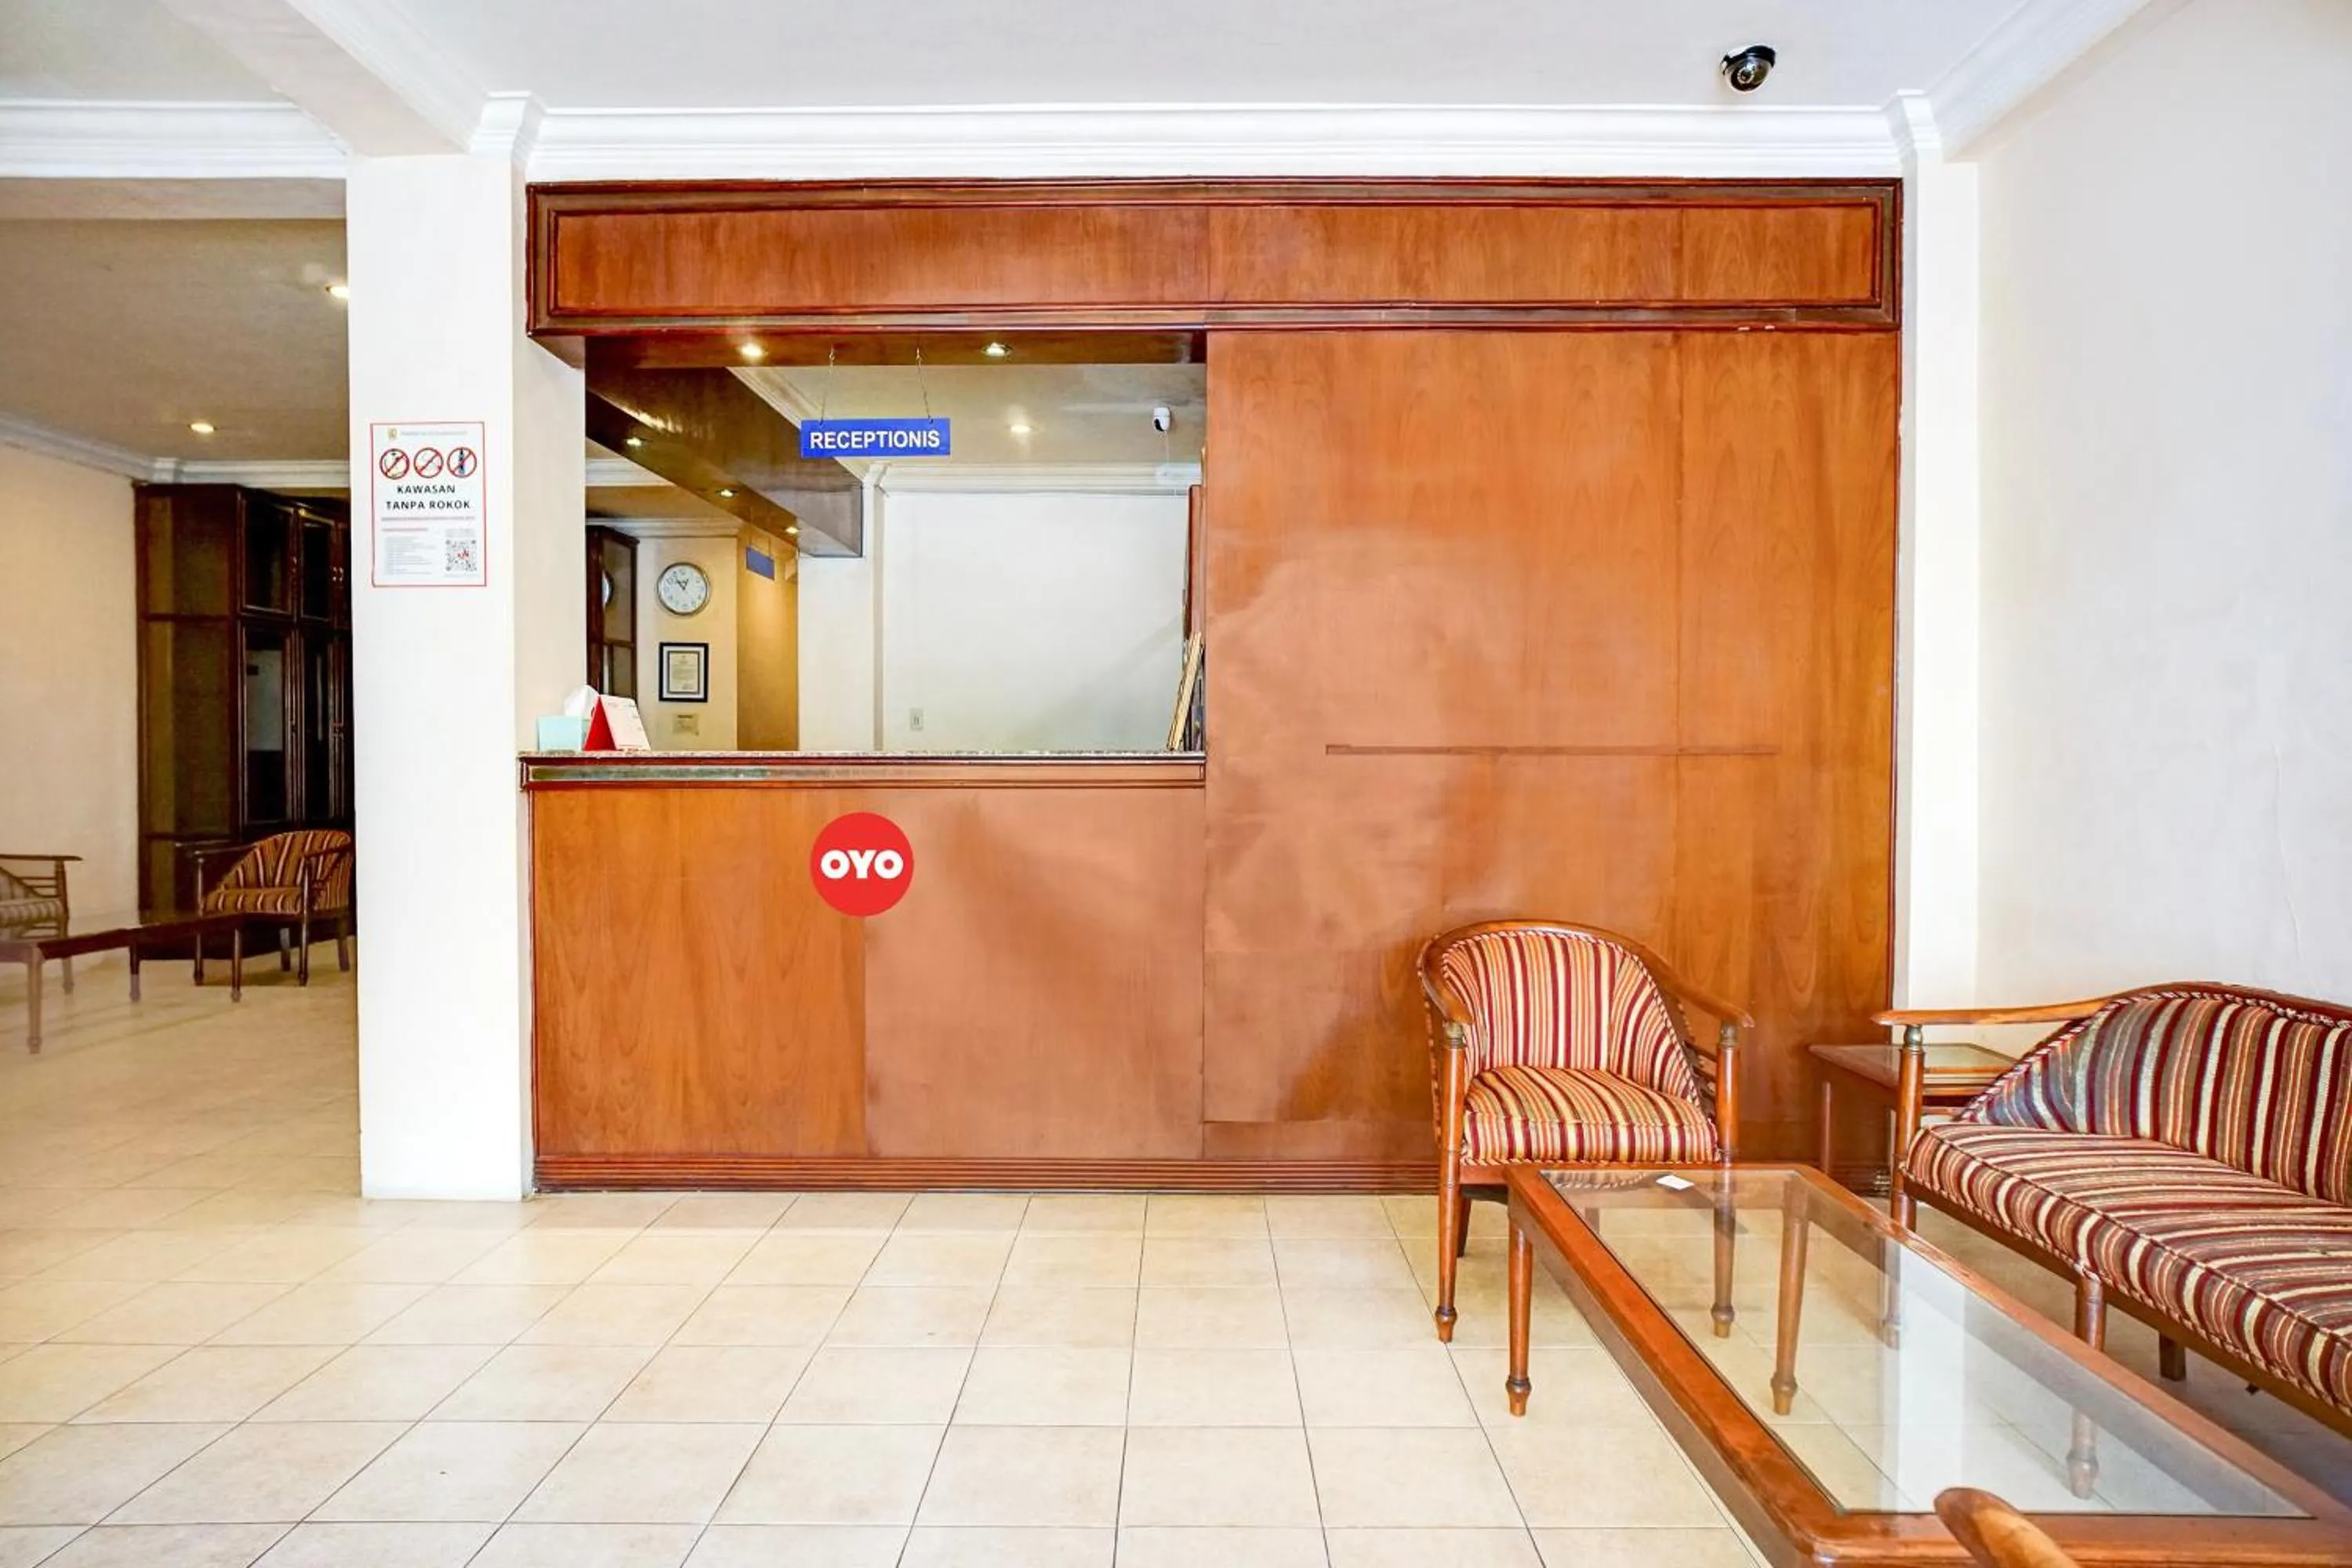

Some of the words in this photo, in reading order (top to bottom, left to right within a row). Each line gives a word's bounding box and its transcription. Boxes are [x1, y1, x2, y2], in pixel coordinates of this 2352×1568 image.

[809, 430, 940, 449] RECEPTIONIS
[397, 485, 456, 494] KAWASAN
[386, 500, 425, 510] TANPA
[429, 499, 470, 510] ROKOK
[821, 849, 904, 879] OYO
